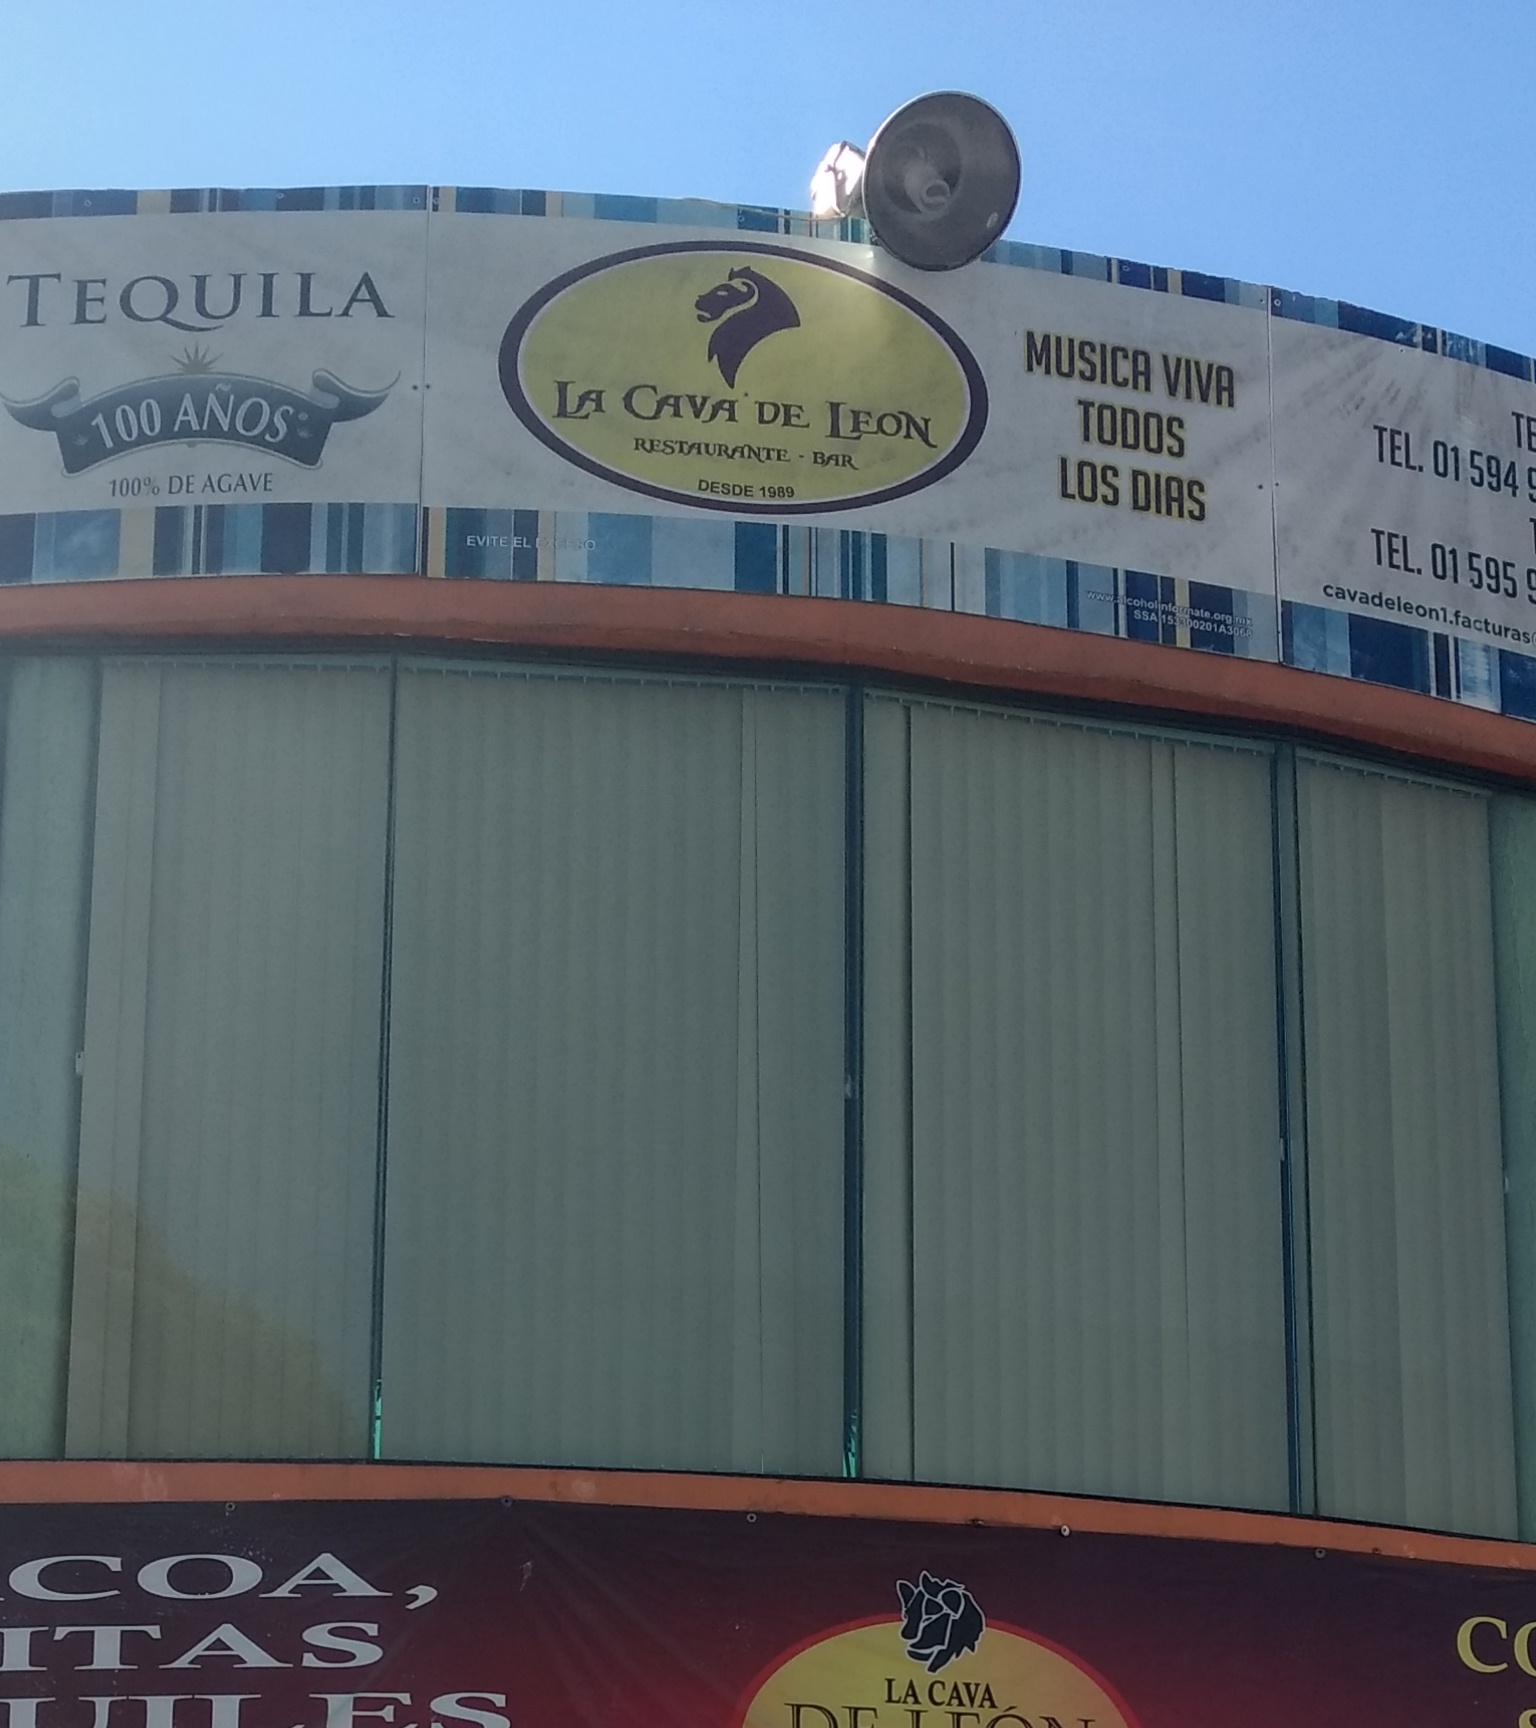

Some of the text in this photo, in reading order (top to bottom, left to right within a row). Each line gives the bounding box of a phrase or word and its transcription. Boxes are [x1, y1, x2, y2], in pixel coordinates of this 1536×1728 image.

[6, 271, 395, 333] TEQUILA
[1026, 330, 1235, 409] MUSICA VIVA
[91, 382, 296, 450] 100 AÑOS
[754, 399, 811, 429] DE
[1077, 398, 1186, 459] TODOS
[632, 436, 791, 465] RESTAURANTE
[812, 451, 860, 471] BAR
[1372, 424, 1424, 474] TEL.
[1432, 439, 1461, 483] 01
[1469, 449, 1520, 499] 594
[107, 472, 274, 498] 100% DE AGAVE
[697, 479, 795, 499] DESDE 1989
[1060, 456, 1206, 522] LOS DIAS
[466, 535, 509, 548] EVITE
[513, 536, 532, 549] EL
[1370, 527, 1423, 576] TEL.
[1430, 542, 1460, 585] 01
[1467, 551, 1519, 600] 595
[1133, 608, 1159, 623] SSA
[884, 1677, 999, 1709] LA CAVA
